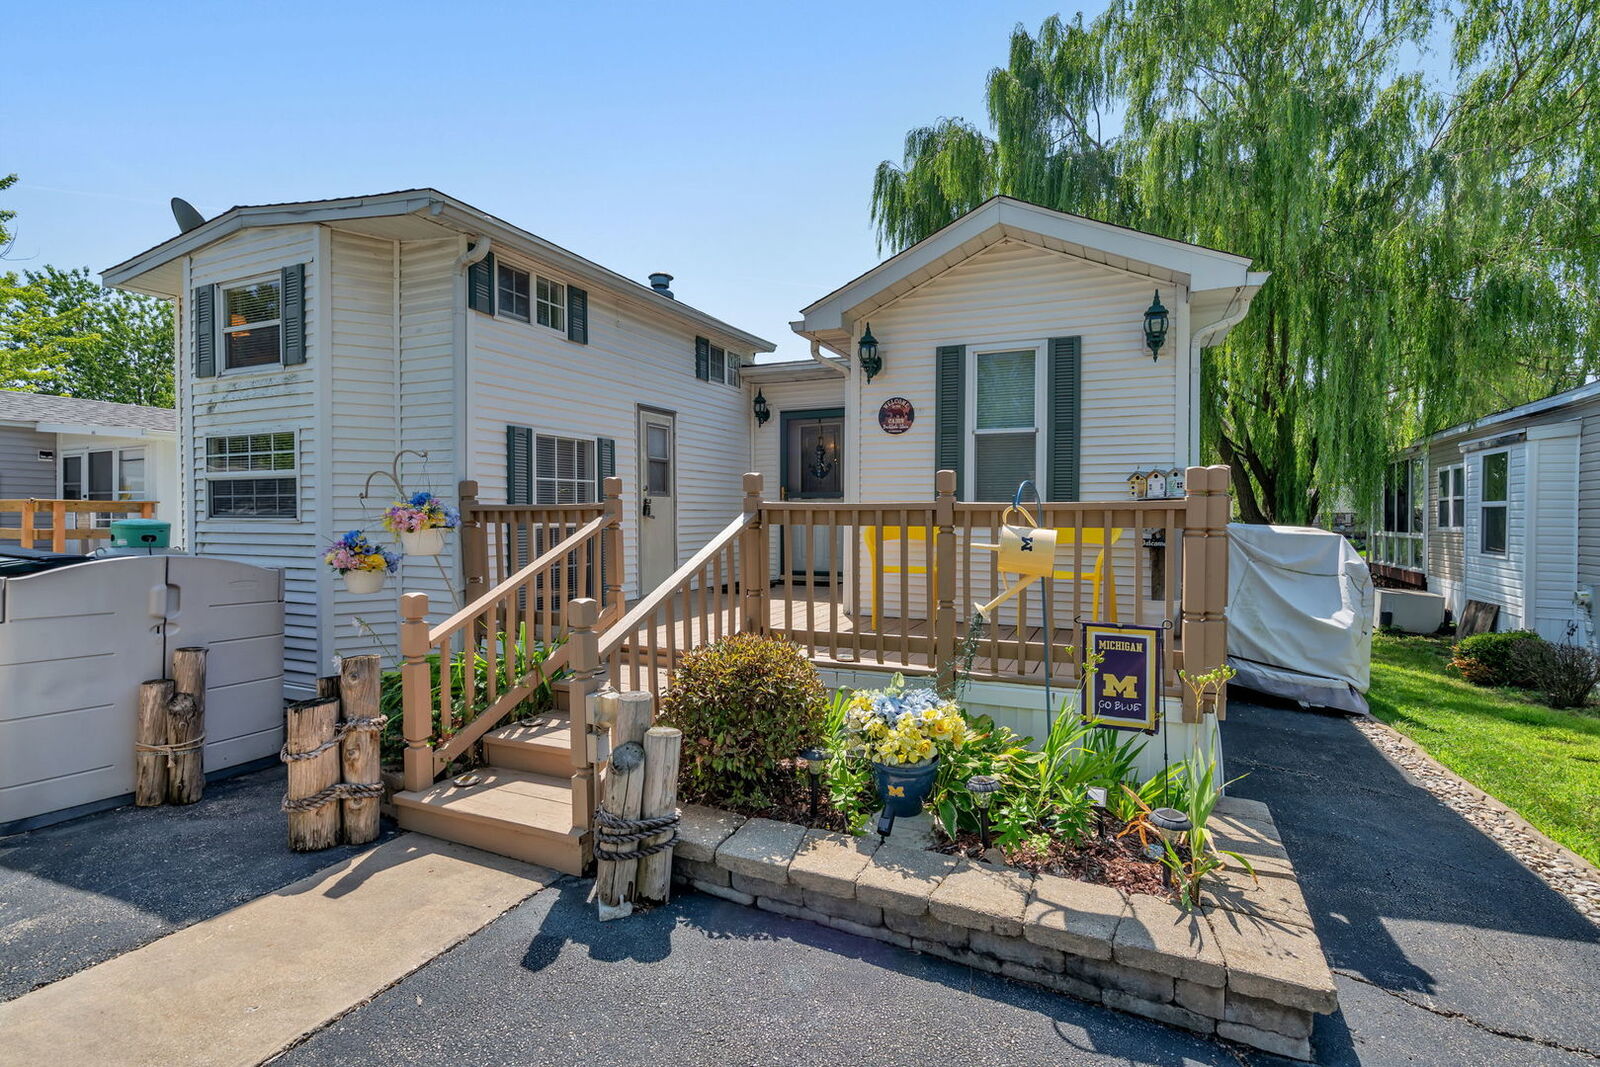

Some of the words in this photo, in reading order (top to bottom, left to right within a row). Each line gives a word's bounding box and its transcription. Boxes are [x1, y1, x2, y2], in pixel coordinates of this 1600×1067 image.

[883, 399, 910, 408] WELCOME
[1021, 537, 1033, 551] M
[1098, 640, 1143, 652] MICHIGAN
[1102, 673, 1138, 698] M
[1099, 700, 1112, 709] GO
[1114, 701, 1142, 711] BLUE
[887, 785, 905, 797] M
